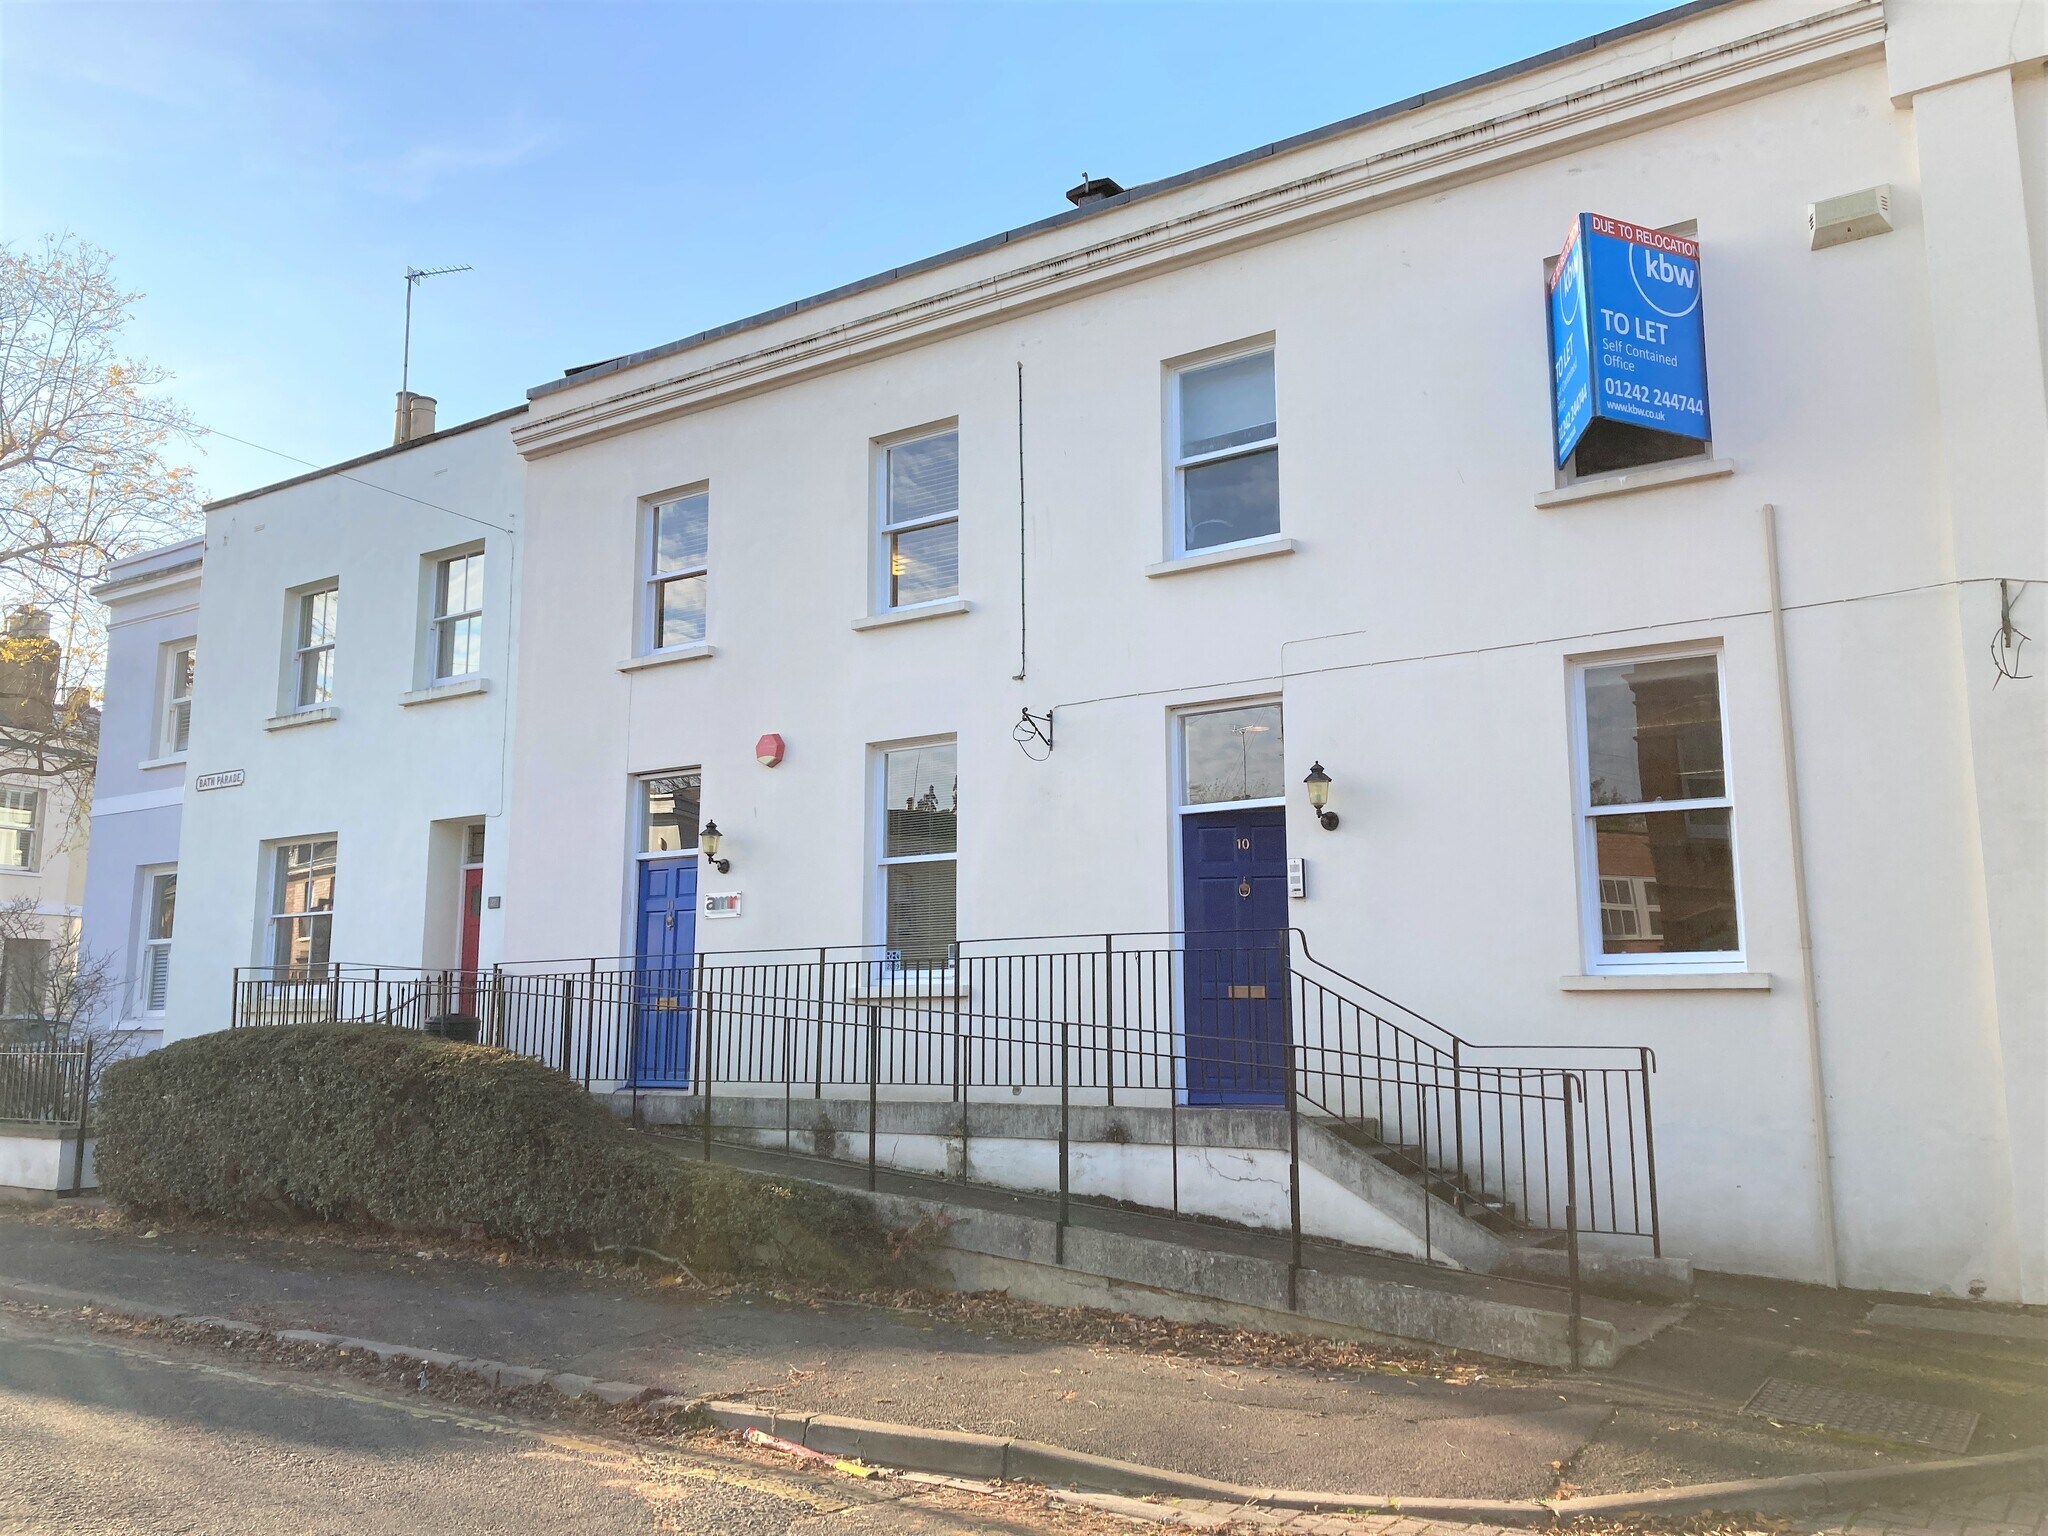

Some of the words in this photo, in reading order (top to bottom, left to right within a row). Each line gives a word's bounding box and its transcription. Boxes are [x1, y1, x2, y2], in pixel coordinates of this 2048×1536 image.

[1592, 216, 1615, 235] DUE
[1618, 223, 1633, 240] TO
[1635, 228, 1699, 257] RELOCATION
[1645, 249, 1695, 289] kbw
[1600, 308, 1630, 335] TO
[1635, 317, 1668, 345] LET
[1564, 332, 1574, 368] LET
[1602, 337, 1622, 353] Self
[1625, 343, 1678, 367] Contained
[1603, 353, 1635, 372] Office
[1605, 377, 1650, 404] 01242
[1653, 388, 1704, 416] 244744
[1606, 400, 1665, 421] www.kbw.co.uk
[199, 777, 215, 787] BATH
[217, 773, 241, 785] PARADE
[1236, 838, 1250, 850] 10
